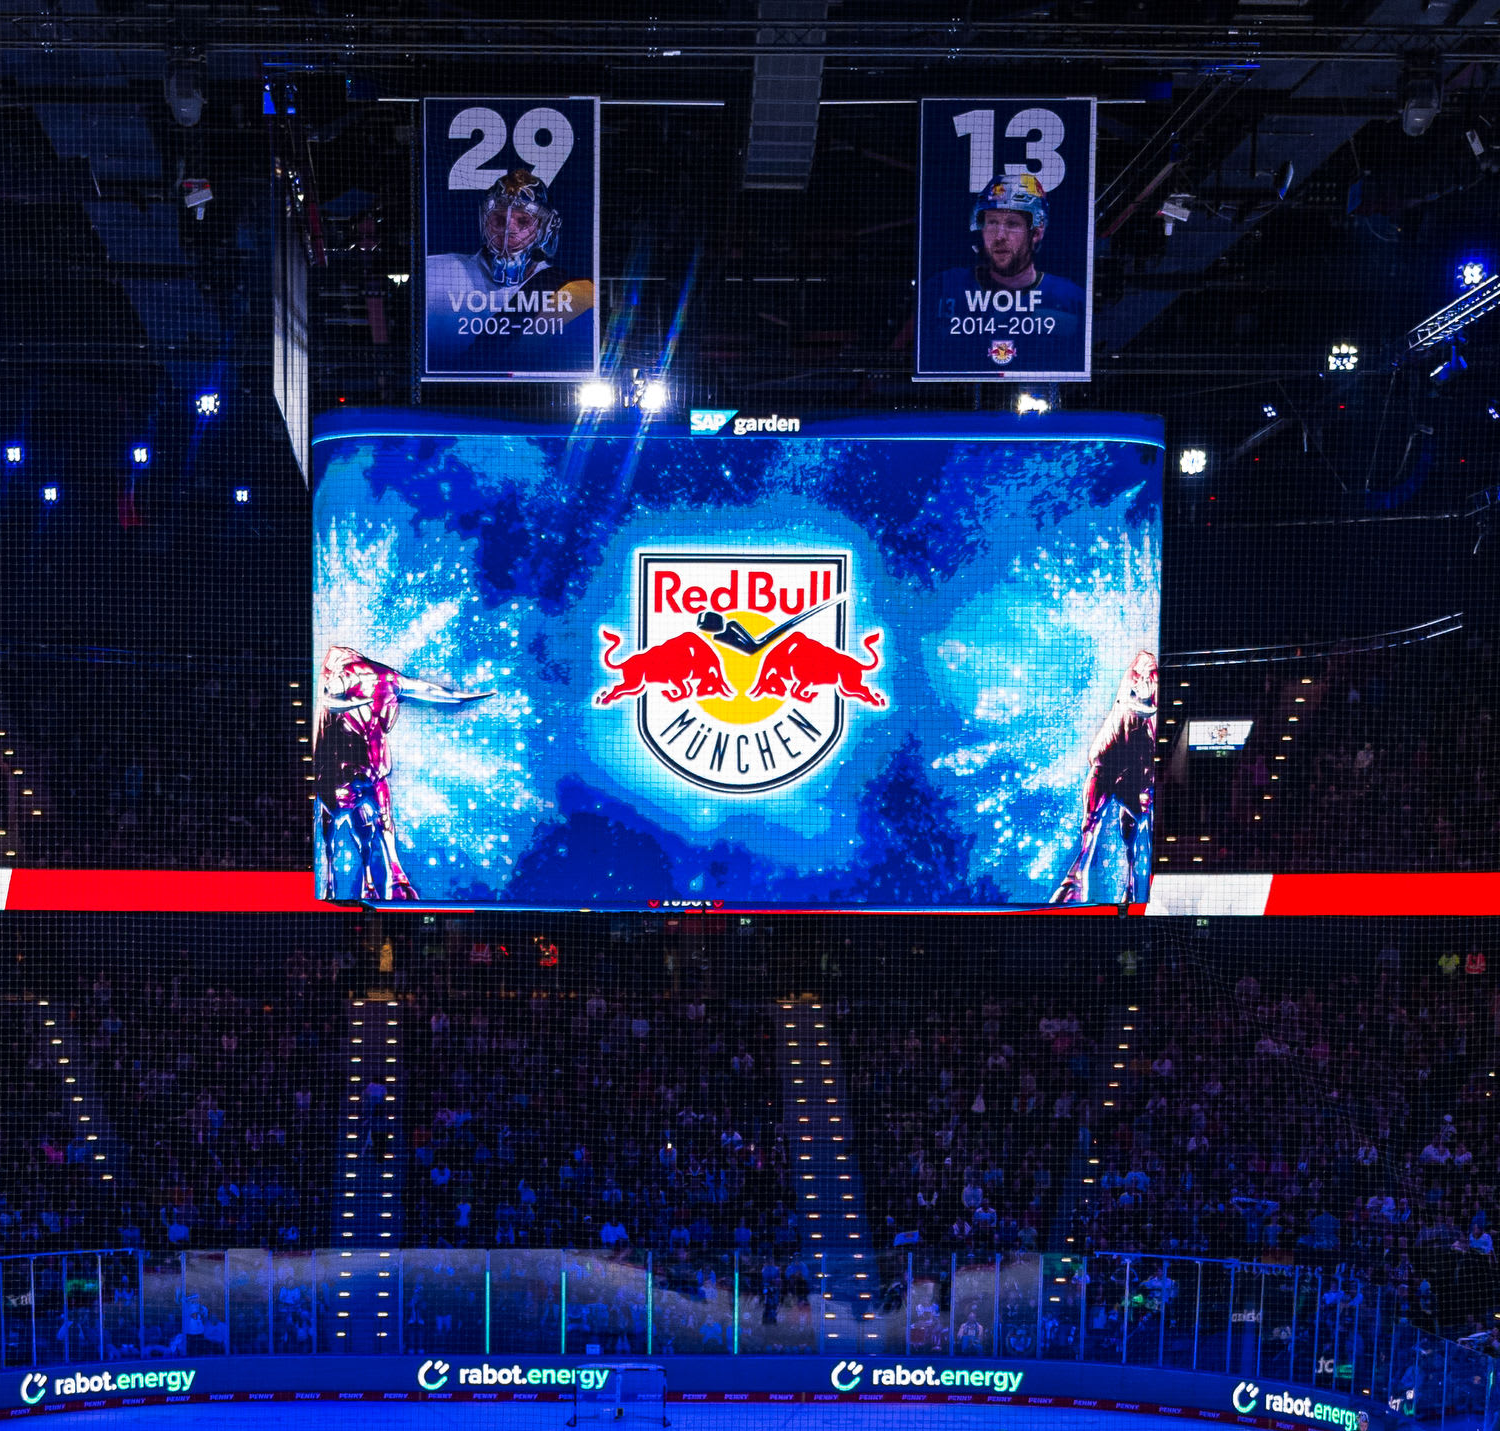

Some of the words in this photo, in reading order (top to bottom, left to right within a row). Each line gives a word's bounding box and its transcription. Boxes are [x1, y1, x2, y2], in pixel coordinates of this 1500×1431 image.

[448, 106, 575, 190] 29
[952, 107, 1066, 194] 13
[448, 289, 573, 313] VOLLMER
[965, 289, 1042, 313] WOLF
[457, 316, 564, 336] 2002-2011
[950, 316, 1056, 336] 2014-2019
[690, 413, 727, 431] SAP
[733, 413, 800, 435] garden
[654, 569, 739, 614] Red
[747, 569, 832, 616] Bull
[659, 708, 822, 774] MÜNCHEN
[55, 1370, 196, 1396] rabot.energy
[460, 1363, 610, 1390] rabot.energy
[872, 1364, 1024, 1393] rabot.energy
